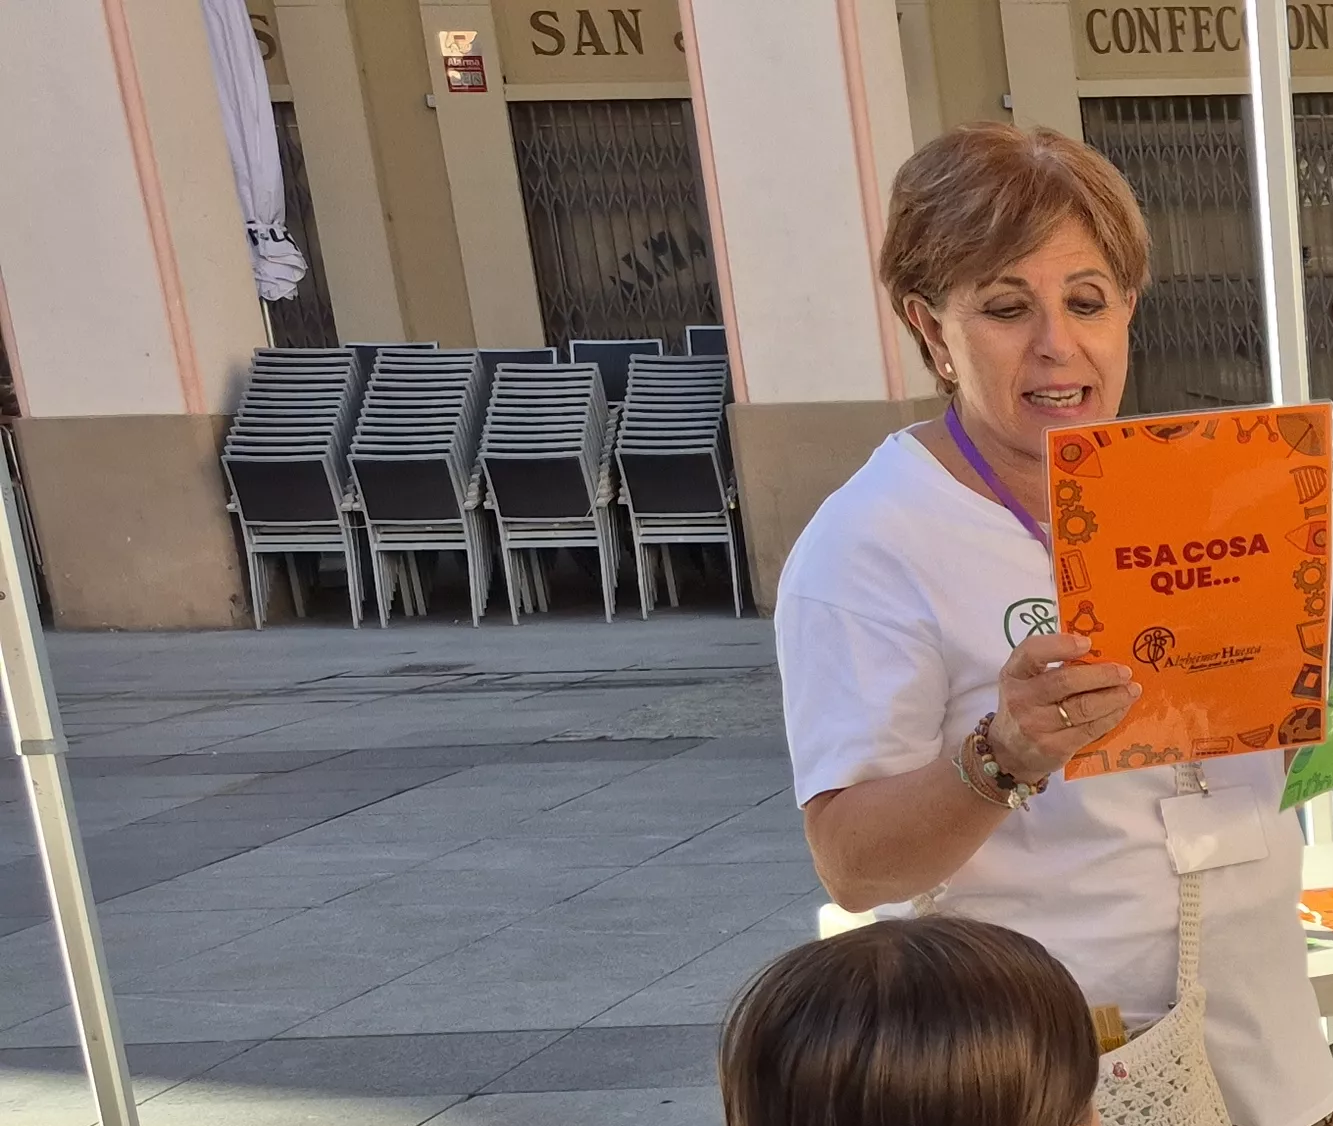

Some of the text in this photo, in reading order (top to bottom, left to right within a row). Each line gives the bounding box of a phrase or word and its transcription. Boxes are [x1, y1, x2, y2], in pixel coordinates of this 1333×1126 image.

[529, 9, 644, 56] SAN
[1115, 533, 1270, 570] ESA COSA
[1150, 566, 1241, 596] QUE...
